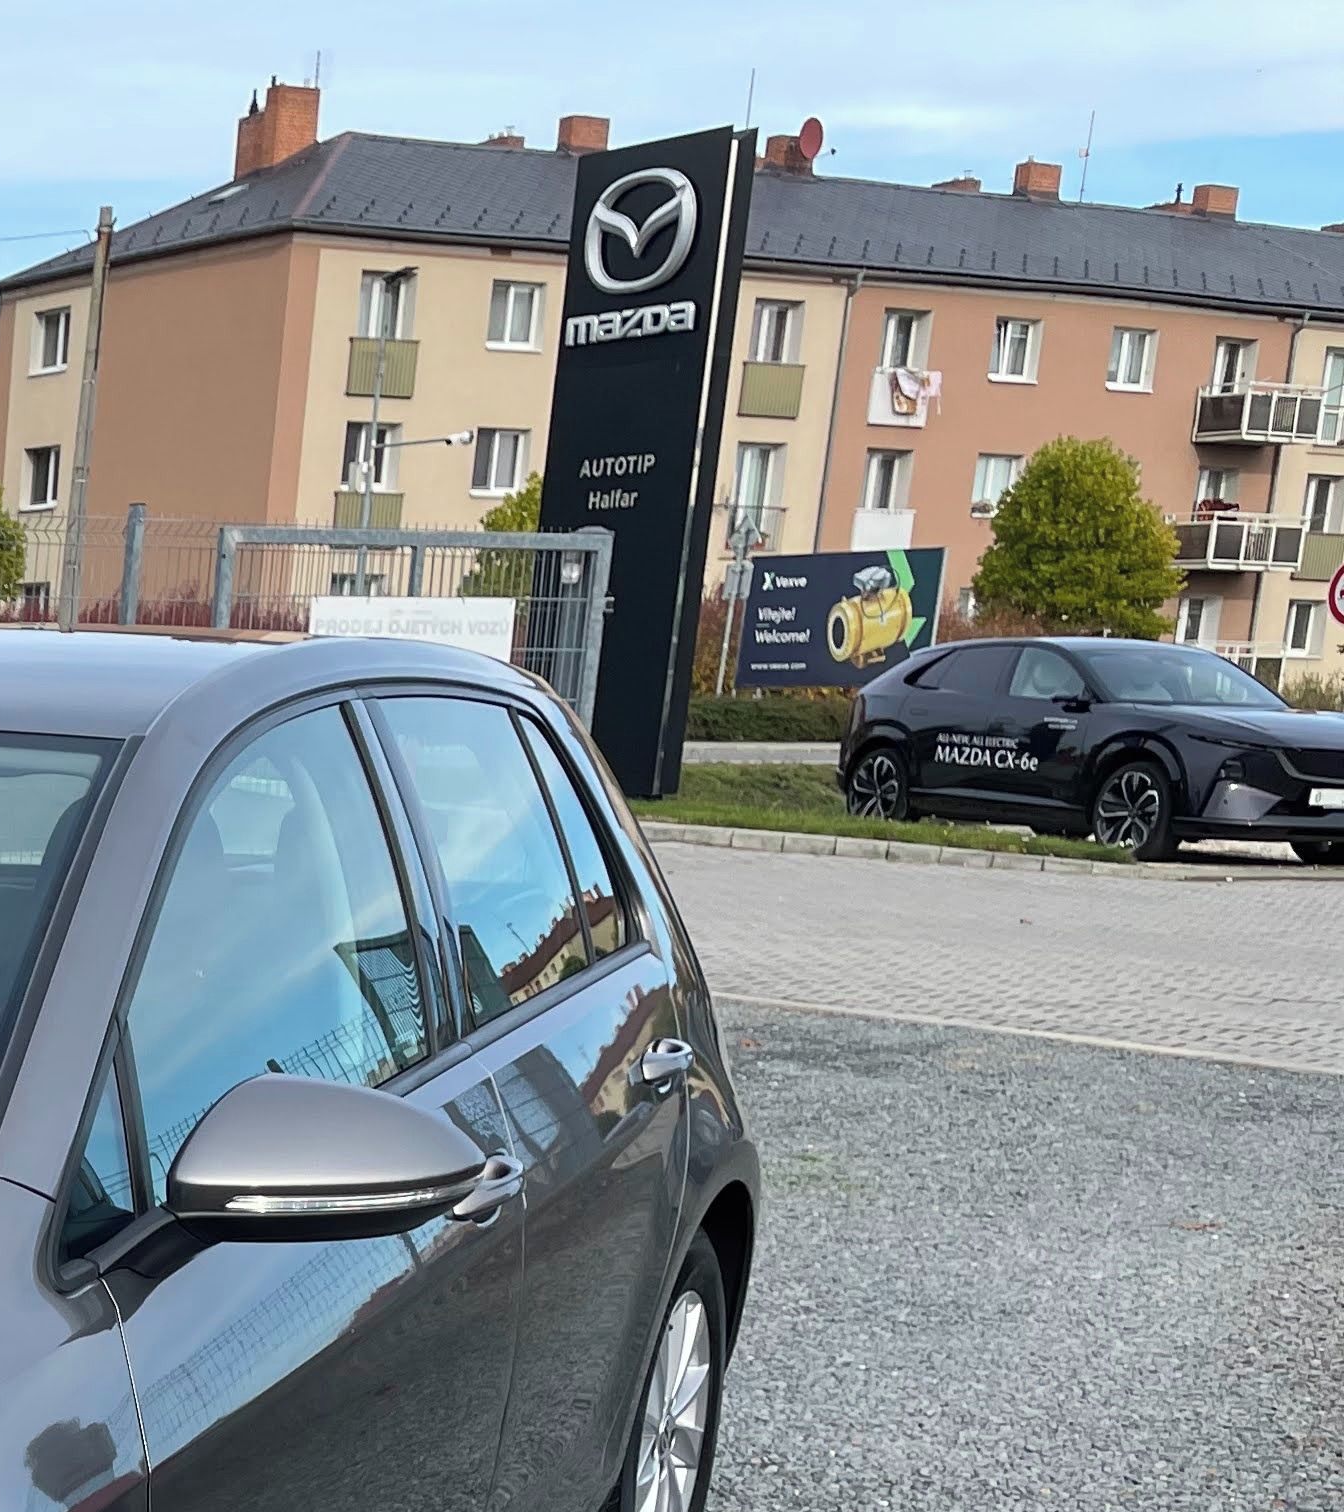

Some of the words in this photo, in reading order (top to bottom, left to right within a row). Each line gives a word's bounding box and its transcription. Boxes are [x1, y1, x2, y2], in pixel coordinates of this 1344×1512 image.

[564, 300, 696, 347] mazda
[578, 453, 656, 479] AUTOTIP
[588, 488, 639, 510] Halfar
[314, 617, 383, 635] PRODEJ
[388, 615, 462, 636] OJETÝCH
[755, 628, 810, 644] Welcome!
[934, 745, 992, 767] MAZDA
[994, 748, 1039, 772] CX-6e
